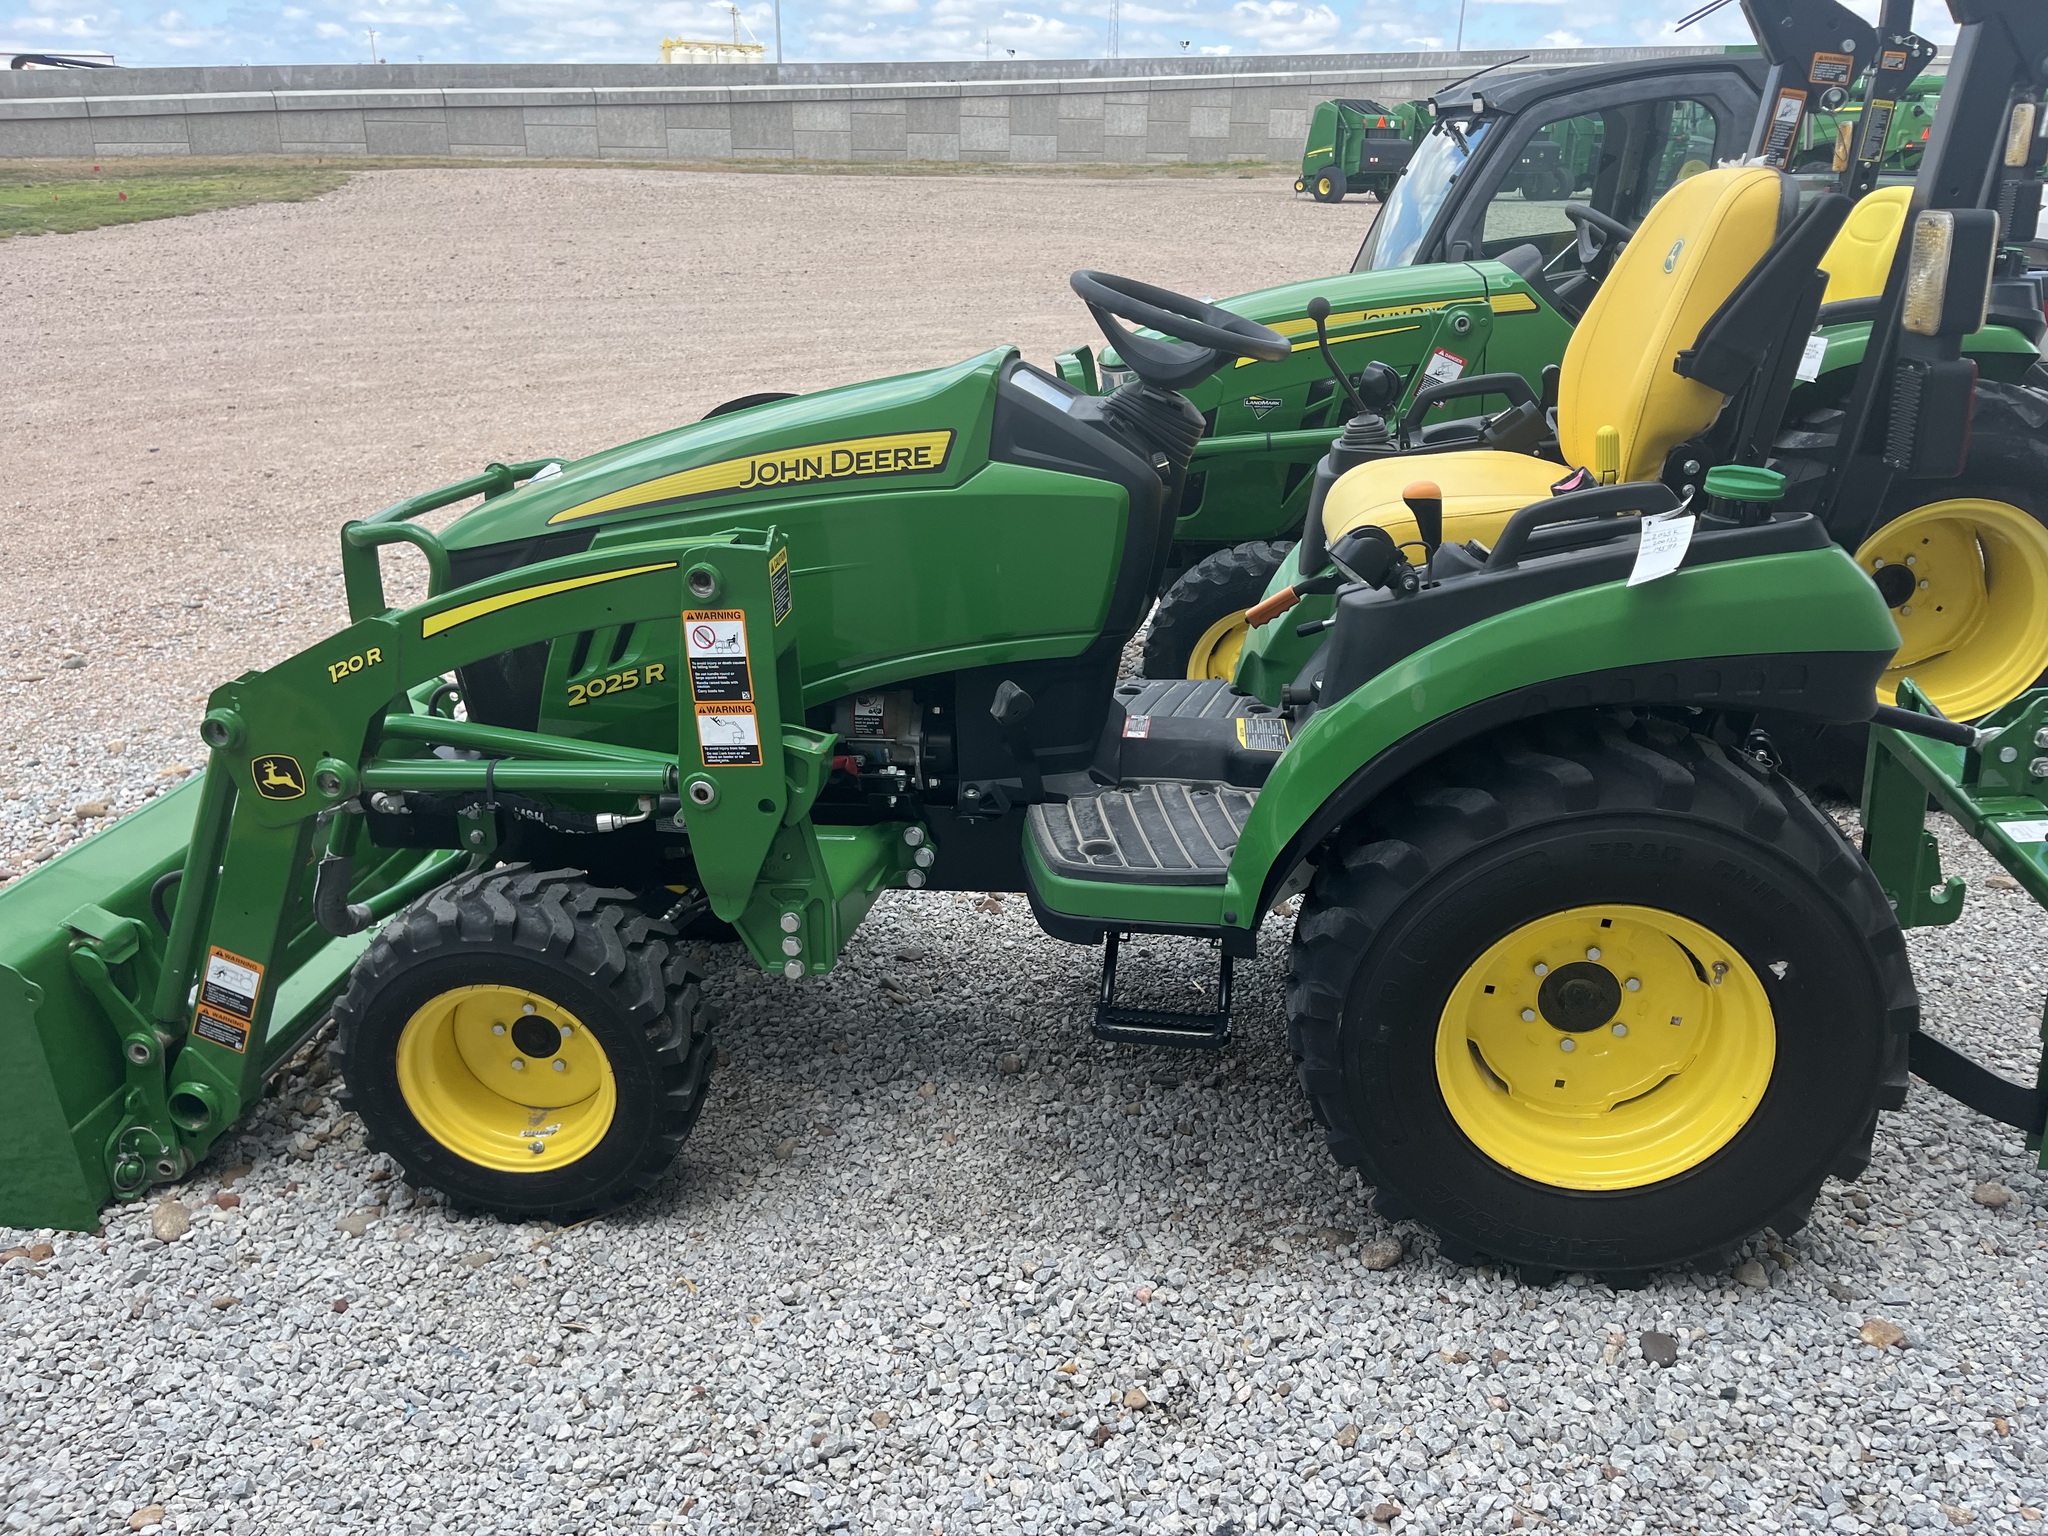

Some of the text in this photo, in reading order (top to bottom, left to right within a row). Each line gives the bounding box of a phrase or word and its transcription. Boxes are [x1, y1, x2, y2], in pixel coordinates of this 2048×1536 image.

[1444, 352, 1462, 364] DANGER
[740, 446, 932, 486] JOHN DEERE
[694, 612, 741, 620] WARNING
[328, 648, 382, 684] 120 R
[568, 664, 664, 706] 2025 R
[706, 705, 752, 714] WARNING
[224, 953, 258, 970] WARNING
[212, 1012, 244, 1028] WARNING
